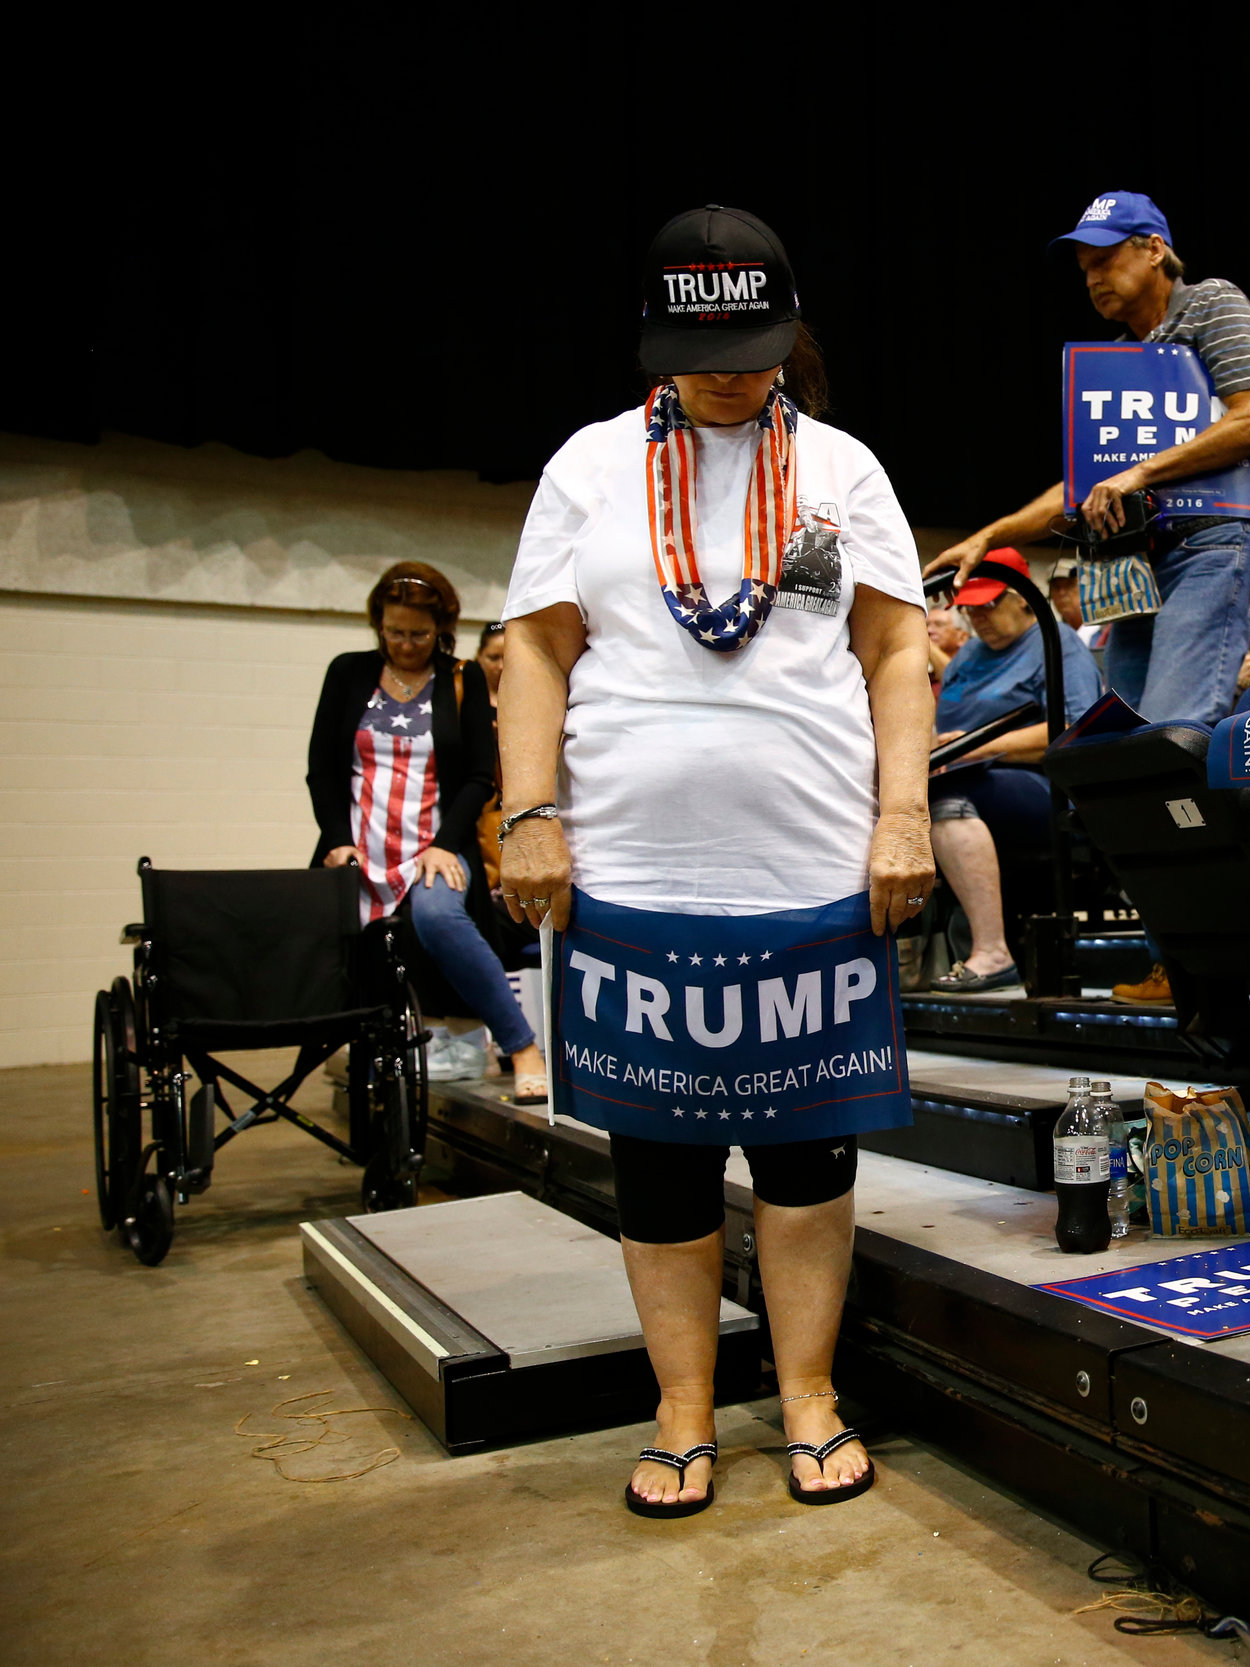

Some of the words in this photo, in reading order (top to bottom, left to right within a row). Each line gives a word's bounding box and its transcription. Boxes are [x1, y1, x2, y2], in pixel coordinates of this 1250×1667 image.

[663, 271, 767, 303] TRUMP
[667, 303, 686, 313] MAKE
[686, 303, 720, 313] AMERICA
[721, 301, 748, 311] GREAT
[748, 301, 770, 310] AGAIN
[1093, 453, 1127, 464] MAKE
[1165, 498, 1204, 508] 2016
[798, 584, 823, 595] SUPPORT
[775, 591, 806, 610] AMERICA
[1180, 804, 1192, 823] 1
[568, 949, 878, 1049] TRUMP
[564, 1040, 618, 1080] MAKE
[623, 1062, 729, 1097] AMERICA
[734, 1063, 813, 1096] GREAT
[815, 1045, 893, 1083] AGAIN!
[1150, 1136, 1196, 1167] POP
[1182, 1146, 1244, 1178] CORN
[1186, 1299, 1240, 1316] MAKE
